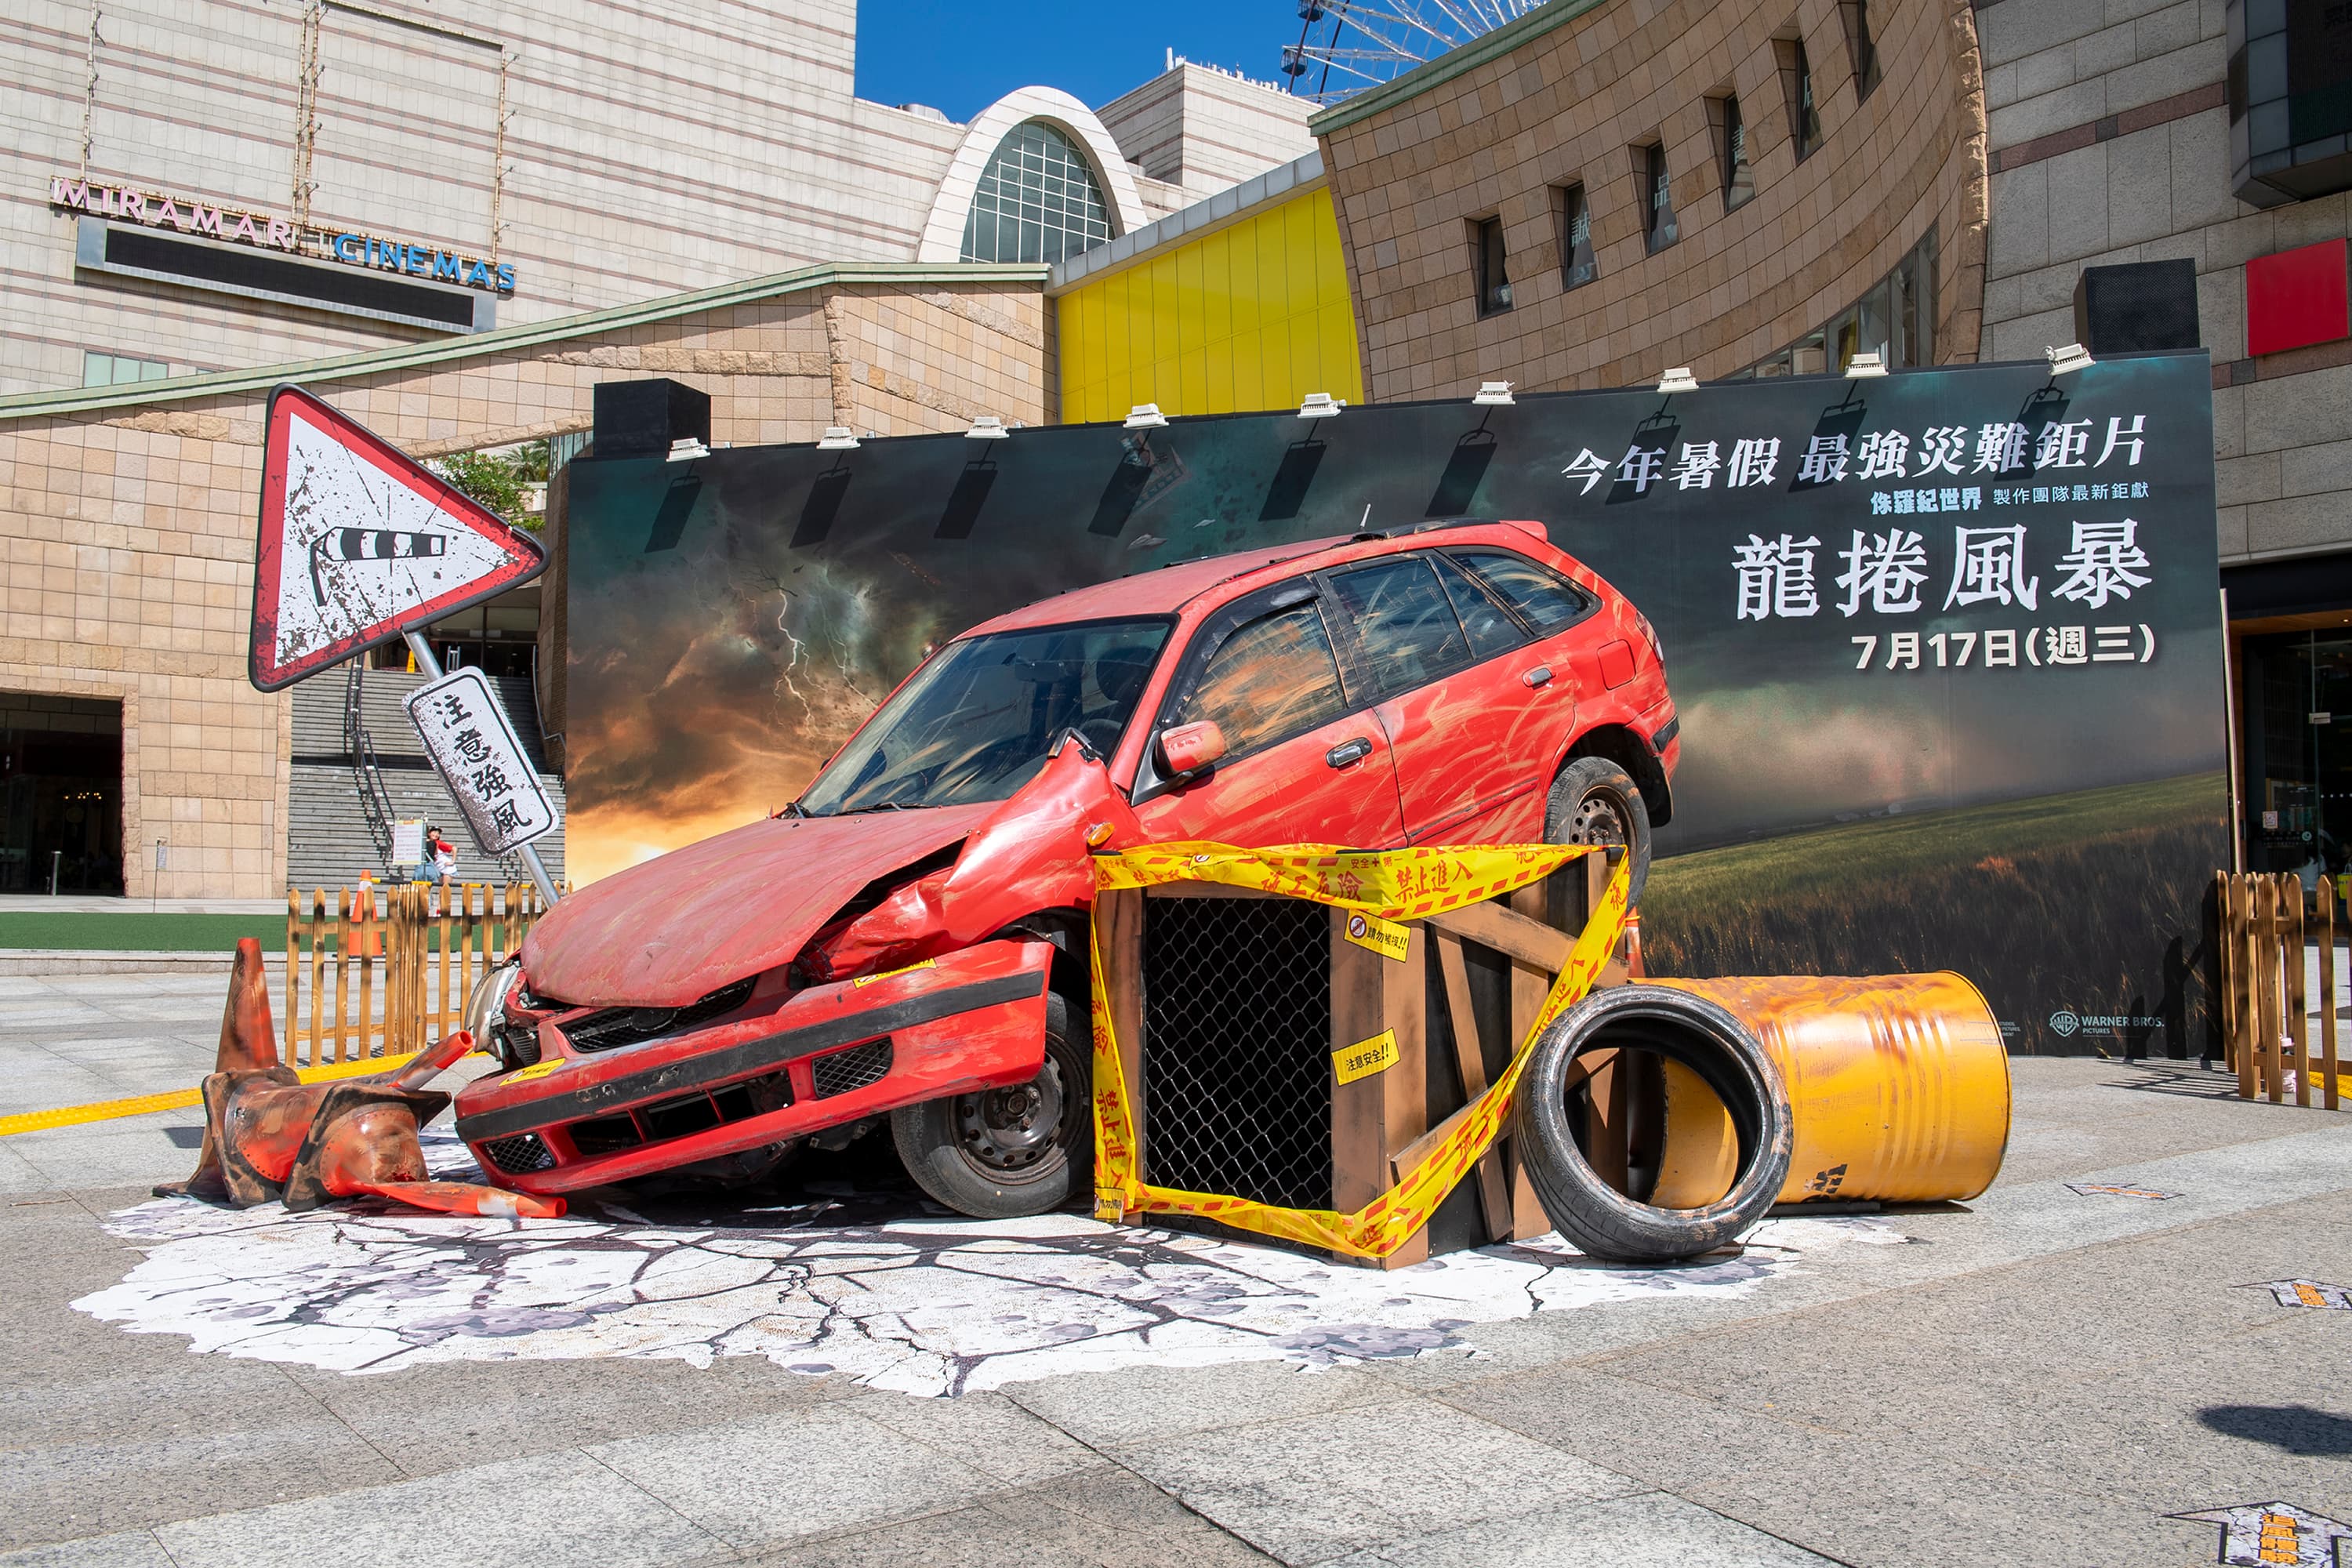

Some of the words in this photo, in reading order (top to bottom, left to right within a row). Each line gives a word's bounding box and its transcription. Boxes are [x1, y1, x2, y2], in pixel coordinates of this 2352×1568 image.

[53, 177, 292, 249] MIRAMAR
[334, 234, 517, 290] CINEMAS
[1561, 436, 1781, 495] 今年暑假
[1797, 415, 2147, 485] 最強災難鉅片
[1870, 487, 1982, 515] 侏羅紀世界
[1992, 481, 2151, 506] 製作團隊最新鉅獻
[1730, 517, 2153, 620] 龍捲風暴
[1850, 624, 2155, 672] 7月17日(週三)
[432, 694, 532, 838] 注意強風
[1394, 858, 1475, 904] 禁止進入
[2081, 1015, 2130, 1028] WARNER
[2132, 1016, 2165, 1028] BROS.
[1345, 1042, 1389, 1072] 注意安全!!
